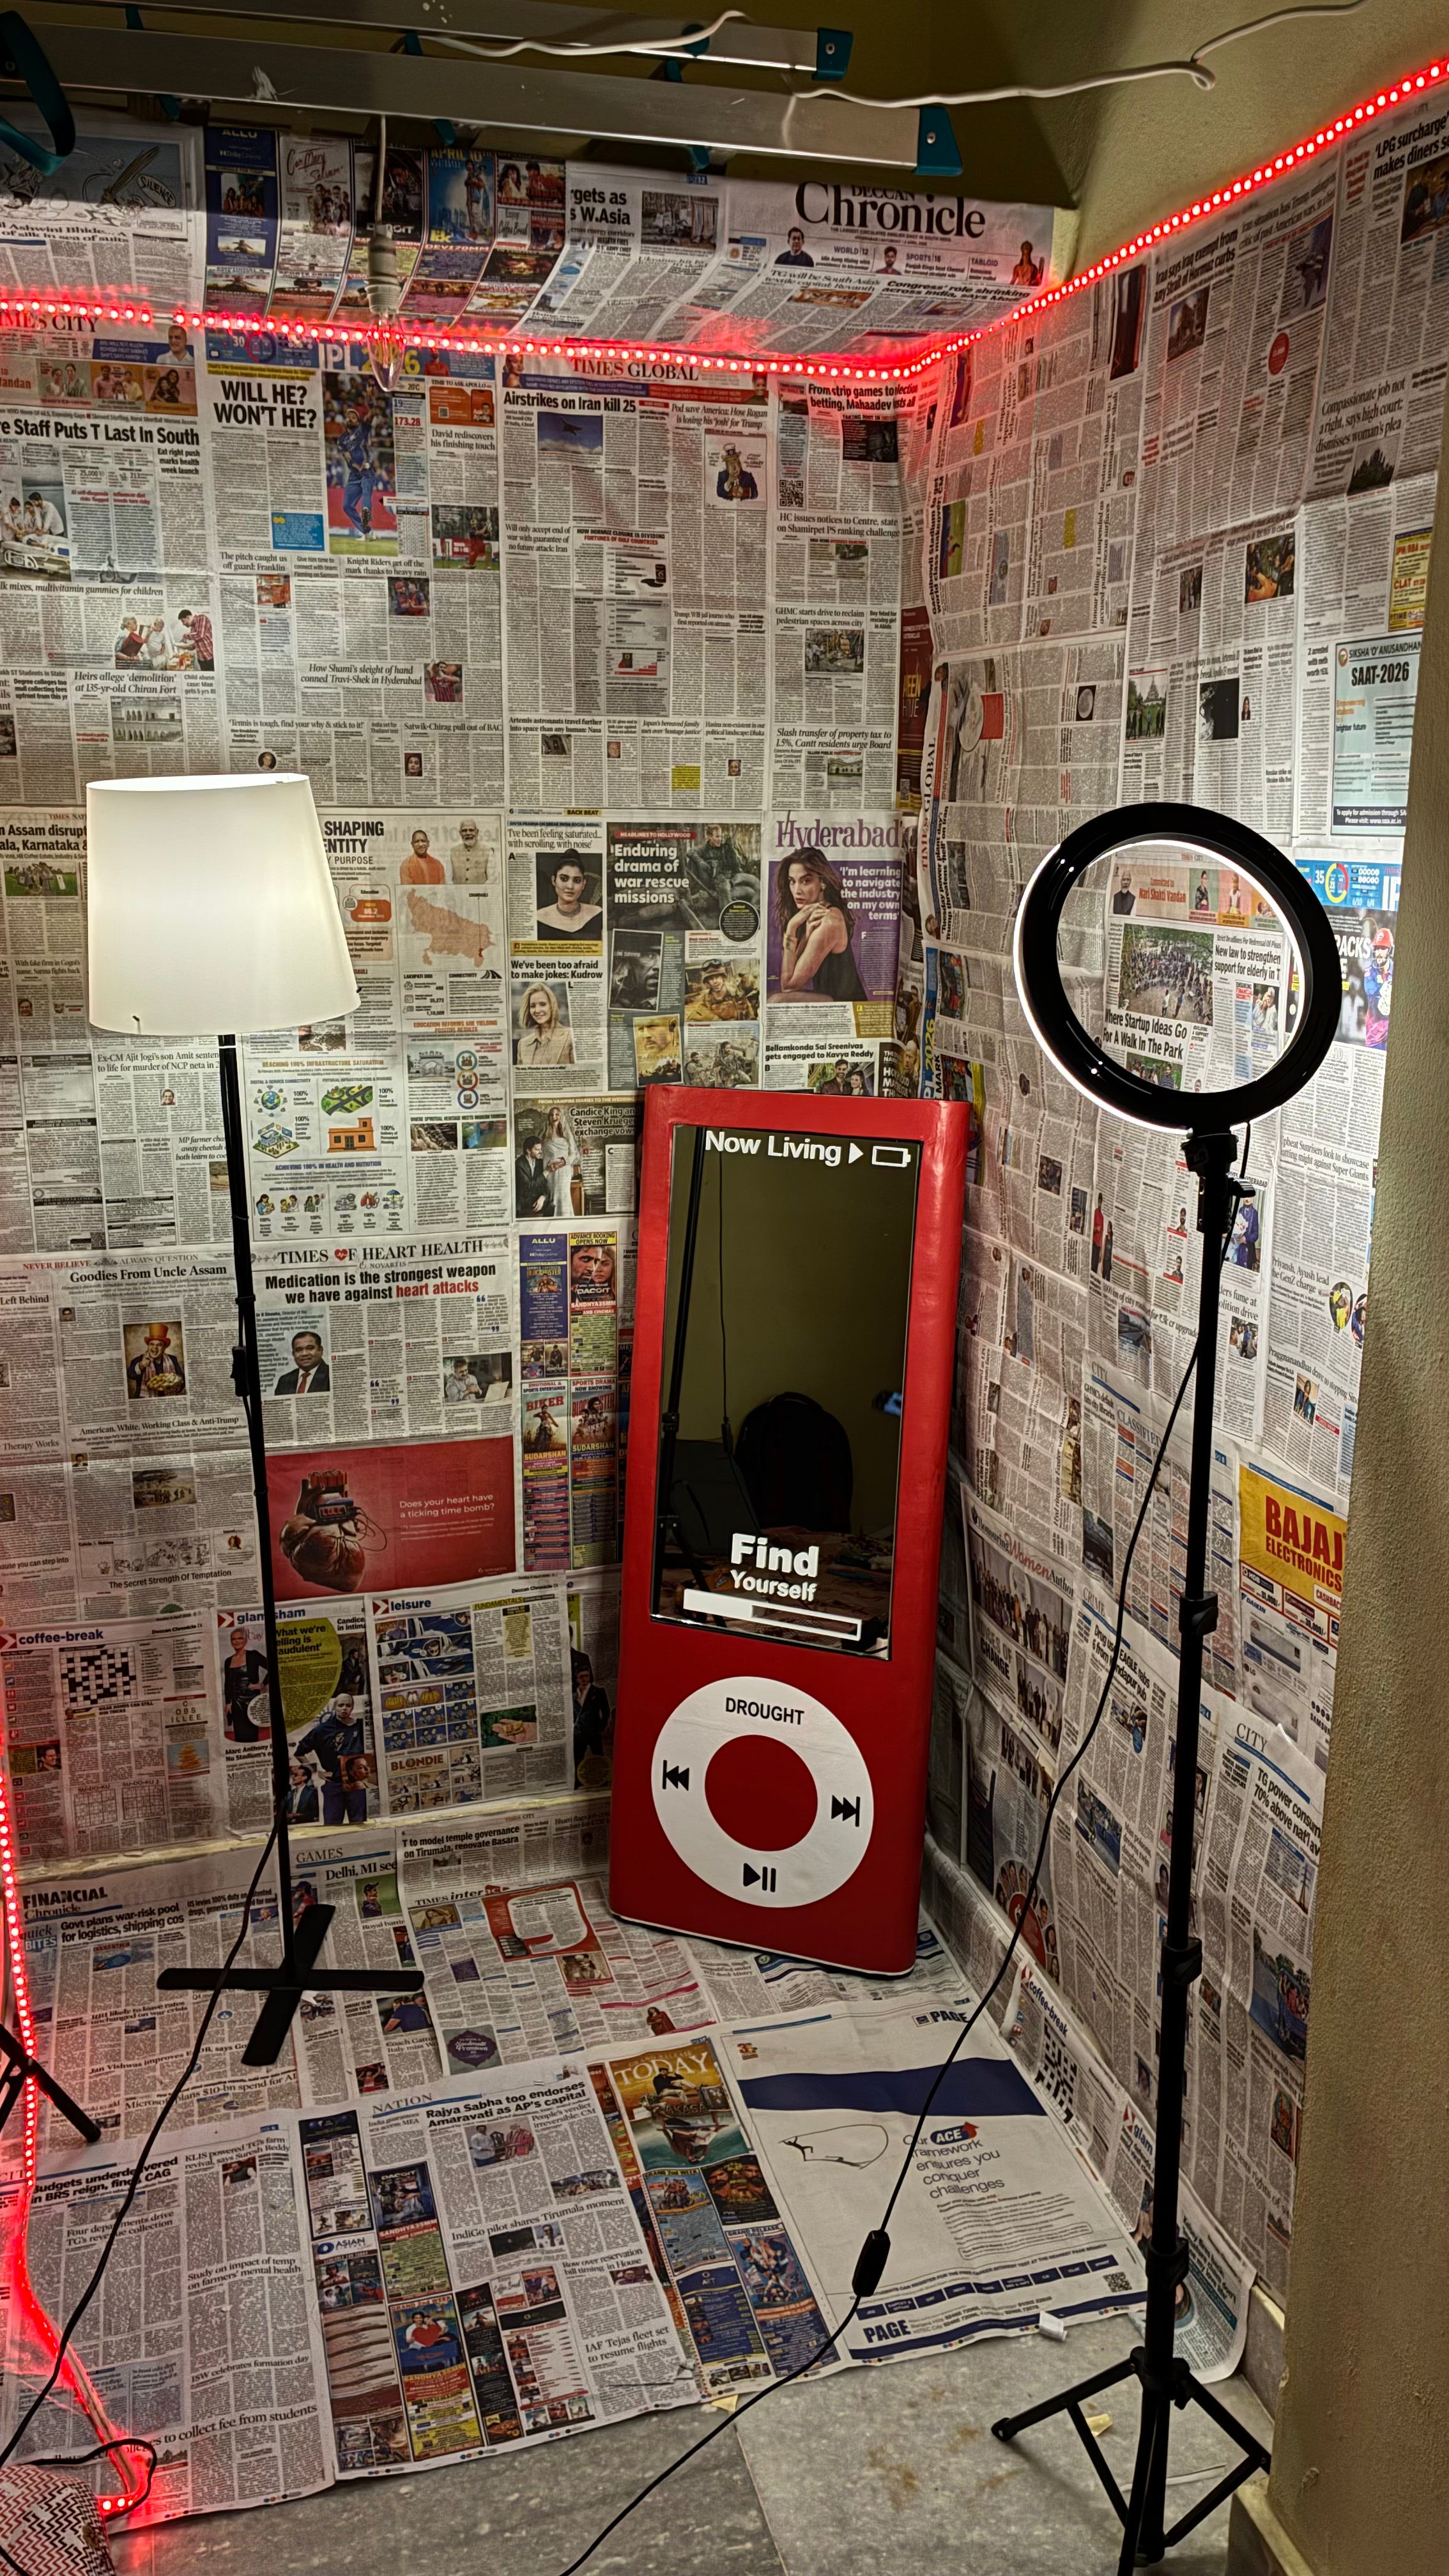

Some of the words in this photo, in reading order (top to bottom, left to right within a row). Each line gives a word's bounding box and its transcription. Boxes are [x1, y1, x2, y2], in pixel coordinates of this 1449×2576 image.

[609, 193, 627, 205] as
[852, 185, 915, 199] DECCAN
[580, 208, 630, 225] W.Asia
[795, 181, 985, 238] Chronicle
[572, 358, 624, 376] TIMES
[629, 360, 699, 381] GLOBAL
[220, 380, 268, 404] WILL
[272, 383, 307, 405] HE?
[503, 391, 558, 409] Airstrikes
[561, 397, 576, 409] on
[578, 395, 601, 411] Iran
[604, 396, 620, 411] kill
[623, 400, 636, 412] 25
[1322, 388, 1377, 416] Compassionate
[1377, 381, 1390, 399] job
[1392, 378, 1406, 393] not
[213, 404, 277, 427] WON'T
[281, 406, 316, 429] HE?
[1319, 424, 1324, 434] a
[1346, 412, 1361, 429] says
[1361, 402, 1379, 423] high
[14, 418, 51, 438] Staff
[54, 421, 87, 440] Puts
[91, 423, 100, 440] T
[103, 424, 135, 443] Last
[139, 425, 153, 442] In
[157, 426, 199, 446] South
[1316, 434, 1350, 453] dismisses
[1353, 421, 1384, 442] woman's
[1384, 416, 1402, 436] plea
[1351, 662, 1409, 686] SAAT-2026
[325, 821, 384, 836] SHAPING
[776, 820, 900, 848] Hyderabad
[335, 856, 373, 864] PURPOSE
[614, 843, 677, 860] Enduring
[614, 859, 661, 873] drama
[664, 859, 678, 873] of
[860, 867, 900, 879] learning
[614, 878, 641, 888] war
[645, 877, 689, 888] rescue
[843, 879, 854, 887] to
[856, 878, 900, 890] navigate
[614, 891, 675, 903] missions
[841, 889, 856, 898] the
[859, 889, 900, 901] industry
[861, 902, 878, 911] my
[511, 960, 534, 969] We've
[536, 960, 556, 969] been
[557, 961, 572, 969] too
[574, 961, 598, 970] afraid
[1215, 945, 1229, 956] New
[1230, 947, 1240, 958] law
[1241, 949, 1247, 958] to
[1248, 949, 1280, 965] strengthen
[545, 970, 569, 980] jokes:
[572, 970, 603, 979] Kudrow
[1215, 961, 1237, 974] support
[1237, 962, 1246, 973] for
[1246, 965, 1267, 979] elderly
[1268, 968, 1274, 977] in
[1124, 1013, 1150, 1034] Startup
[1151, 1018, 1173, 1034] Ideas
[1174, 1023, 1187, 1039] Go
[1103, 1027, 1112, 1043] For
[1114, 1031, 1120, 1044] A
[1121, 1032, 1137, 1049] Walk
[1138, 1035, 1146, 1051] In
[1147, 1038, 1162, 1055] The
[1165, 1041, 1183, 1059] Park
[705, 1131, 761, 1154] Now
[768, 1136, 841, 1167] Living
[278, 1250, 328, 1264] TIMES
[362, 1245, 417, 1260] HEART
[421, 1240, 483, 1256] HEALTH
[70, 1270, 117, 1284] Goodies
[121, 1268, 150, 1280] From
[154, 1266, 186, 1278] Uncle
[190, 1264, 227, 1276] Assam
[265, 1274, 340, 1289] Medication
[344, 1274, 356, 1285] is
[359, 1273, 379, 1285] the
[384, 1268, 442, 1283] strongest
[447, 1264, 496, 1279] weapon
[285, 1292, 305, 1304] we
[309, 1289, 340, 1303] have
[344, 1287, 392, 1301] against
[396, 1283, 429, 1298] heart
[433, 1279, 479, 1294] attacks
[524, 1450, 566, 1460] SUDARSHAN
[572, 1442, 613, 1452] SUDARSHAN
[399, 1500, 422, 1508] Does
[424, 1499, 444, 1508] your
[447, 1495, 470, 1504] heart
[472, 1493, 493, 1501] have
[408, 1509, 440, 1518] ticking
[441, 1506, 461, 1514] time
[466, 1503, 494, 1512] bomb?
[1266, 1495, 1342, 1571] BAJAJ
[731, 1533, 819, 1577] Find
[1004, 1532, 1050, 1580] Women
[1266, 1536, 1342, 1592] ELECTRONICS
[730, 1569, 816, 1601] Yourself
[390, 1598, 431, 1611] leisure
[1247, 1597, 1266, 1614] DAIKIN
[19, 1630, 103, 1644] coffee-break
[980, 1637, 1010, 1679] CHANGE
[725, 1697, 804, 1725] DROUGHT
[1236, 1722, 1268, 1754] CITY
[296, 1848, 342, 1863] GAMES
[22, 1887, 107, 1908] FINANCIAL
[930, 2009, 969, 2024] PAGE
[618, 2052, 709, 2085] TODAY
[373, 2093, 432, 2115] NATION
[427, 2106, 460, 2120] Rajya
[464, 2099, 503, 2113] Sabha
[506, 2094, 525, 2104] too
[530, 2082, 585, 2099] endorses
[428, 2112, 493, 2128] Amaravati
[514, 2101, 538, 2112] AP's
[542, 2090, 586, 2107] capital
[936, 2130, 962, 2143] ACE
[916, 2157, 971, 2172] ensures
[974, 2150, 1000, 2163] you
[923, 2170, 979, 2186] conquer
[930, 2179, 1004, 2198] challenges
[863, 2320, 911, 2343] PAGE
